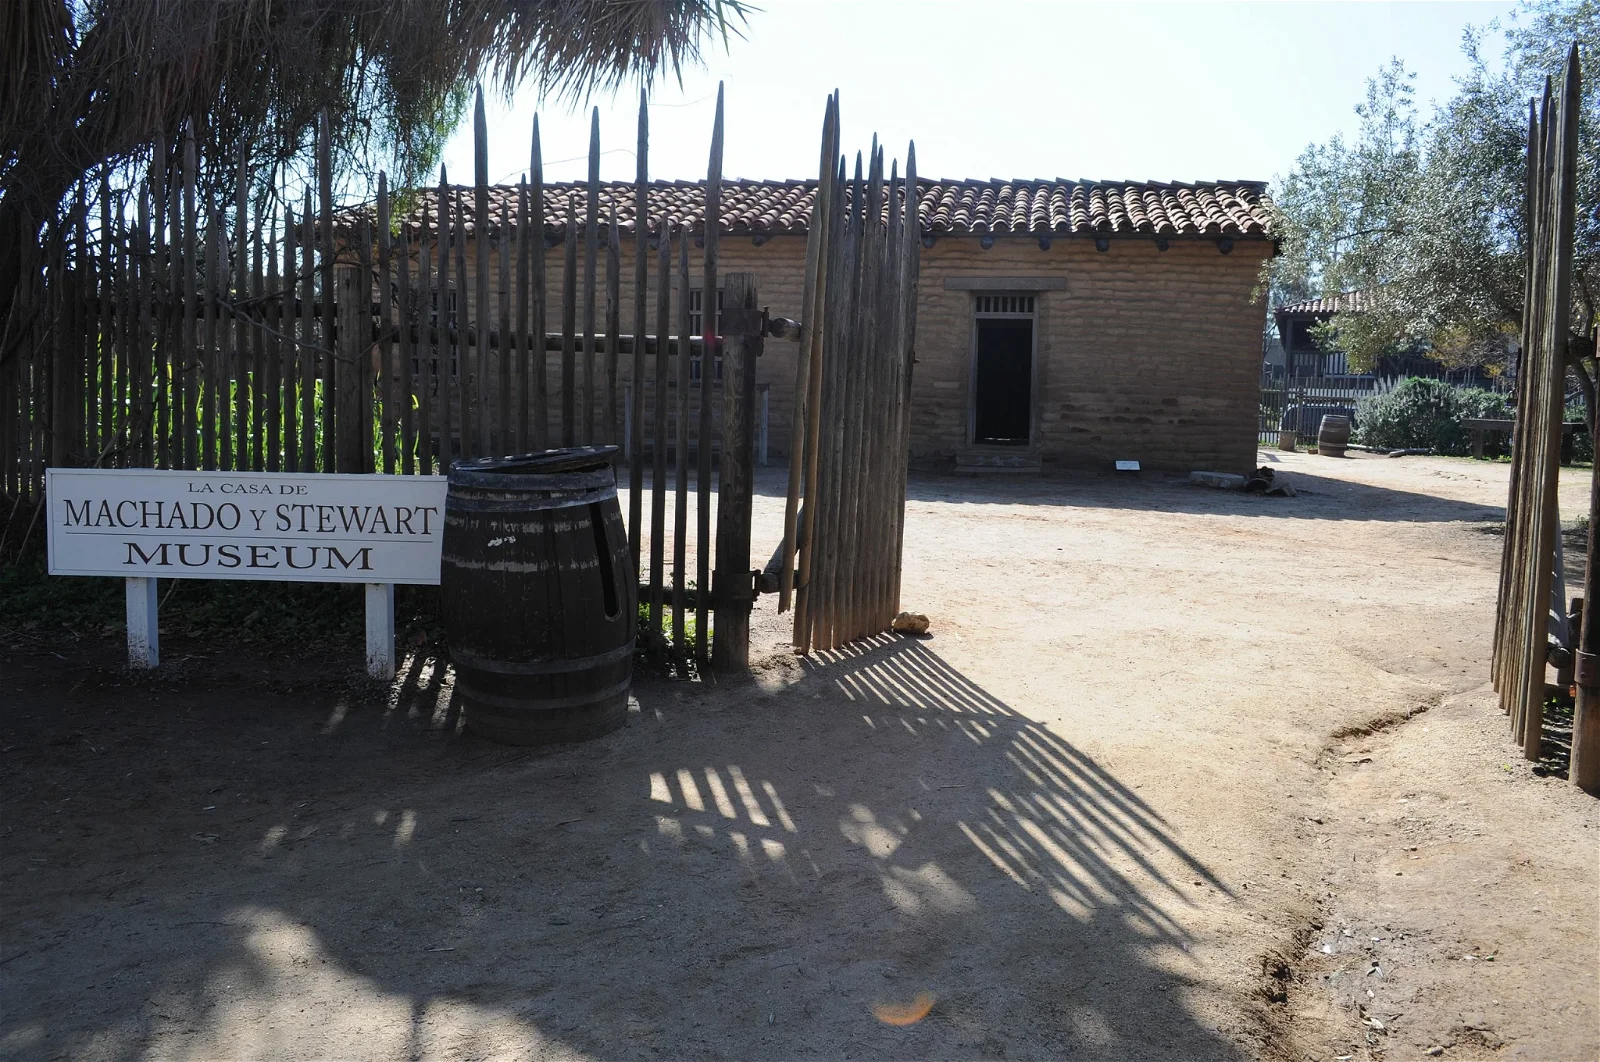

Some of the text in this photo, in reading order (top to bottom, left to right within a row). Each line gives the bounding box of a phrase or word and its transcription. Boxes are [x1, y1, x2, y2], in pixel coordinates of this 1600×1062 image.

[187, 482, 309, 496] LA CASA DE
[63, 499, 242, 531] MACHADO
[276, 503, 438, 535] STEWART
[122, 542, 374, 571] MUSEUM
